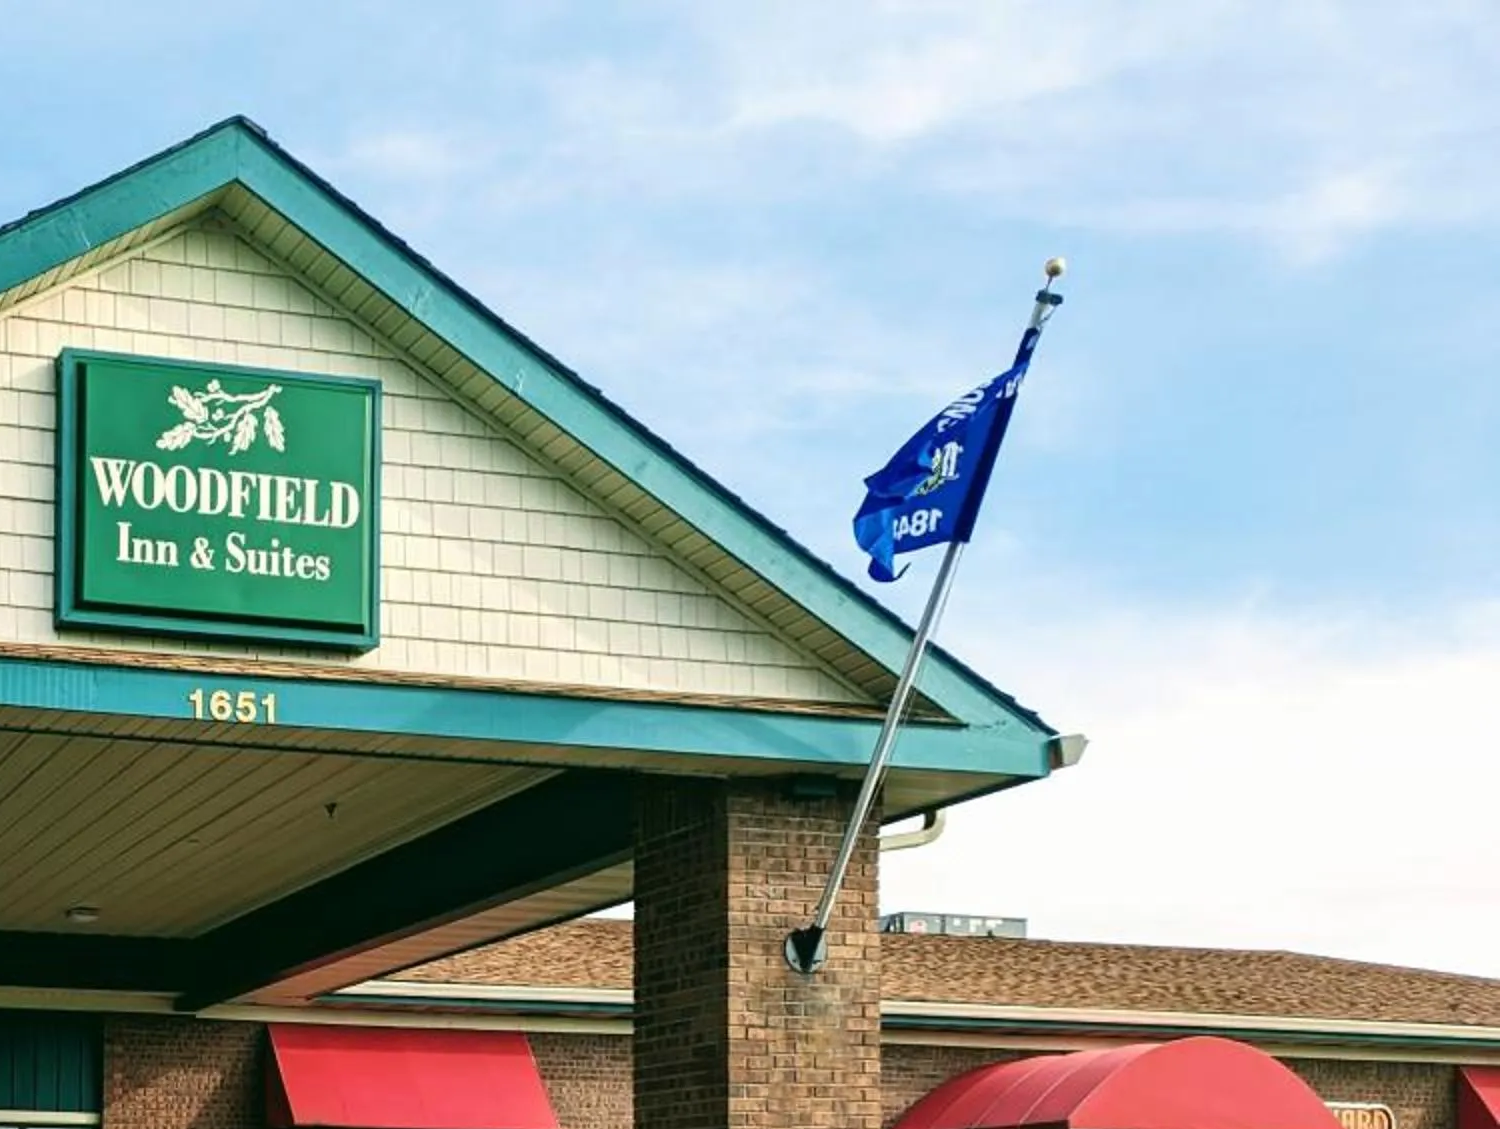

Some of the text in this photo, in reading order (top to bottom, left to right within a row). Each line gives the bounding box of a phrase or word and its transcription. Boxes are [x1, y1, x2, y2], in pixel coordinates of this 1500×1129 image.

[90, 456, 360, 529] WOODFIELD
[116, 522, 331, 581] Inn & Suites
[190, 688, 277, 723] 1651
